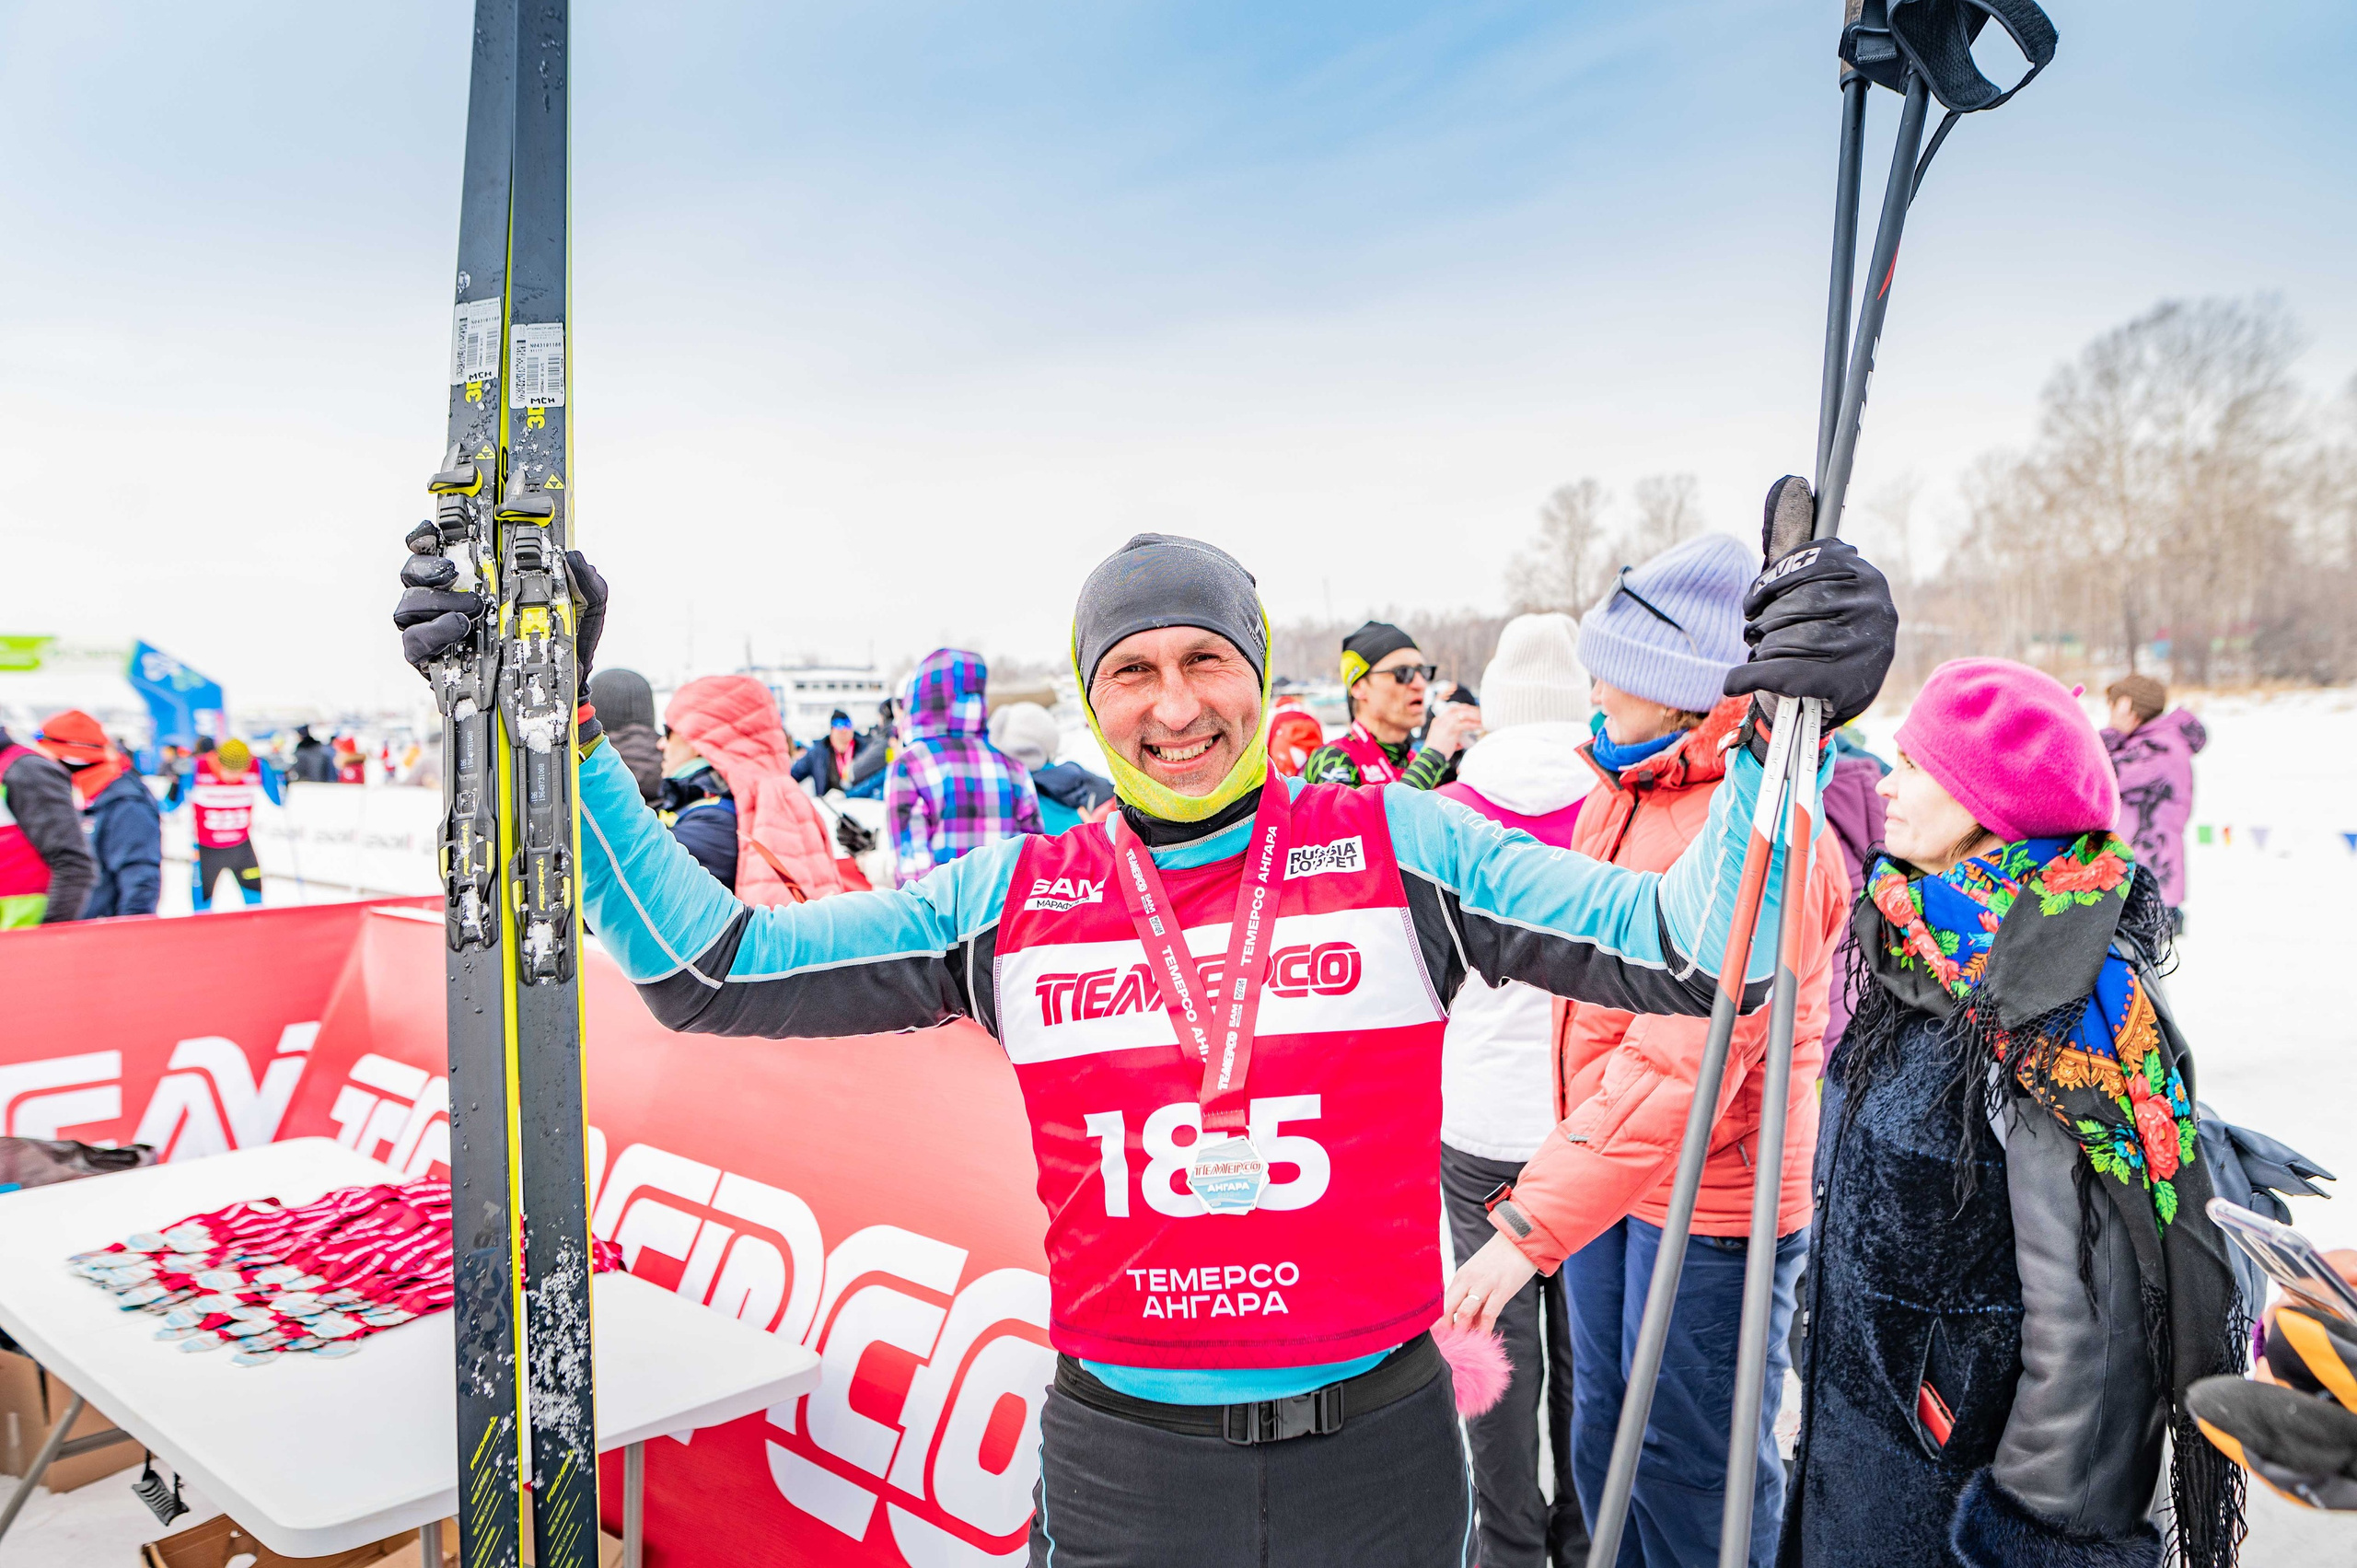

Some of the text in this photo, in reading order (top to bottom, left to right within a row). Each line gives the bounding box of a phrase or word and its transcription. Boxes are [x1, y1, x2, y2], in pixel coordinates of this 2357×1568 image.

[1258, 826, 1278, 884] АНГАРА
[1083, 1094, 1330, 1217] 185
[1207, 1182, 1249, 1193] АНГАРА
[1142, 1290, 1289, 1319] АНГАРА
